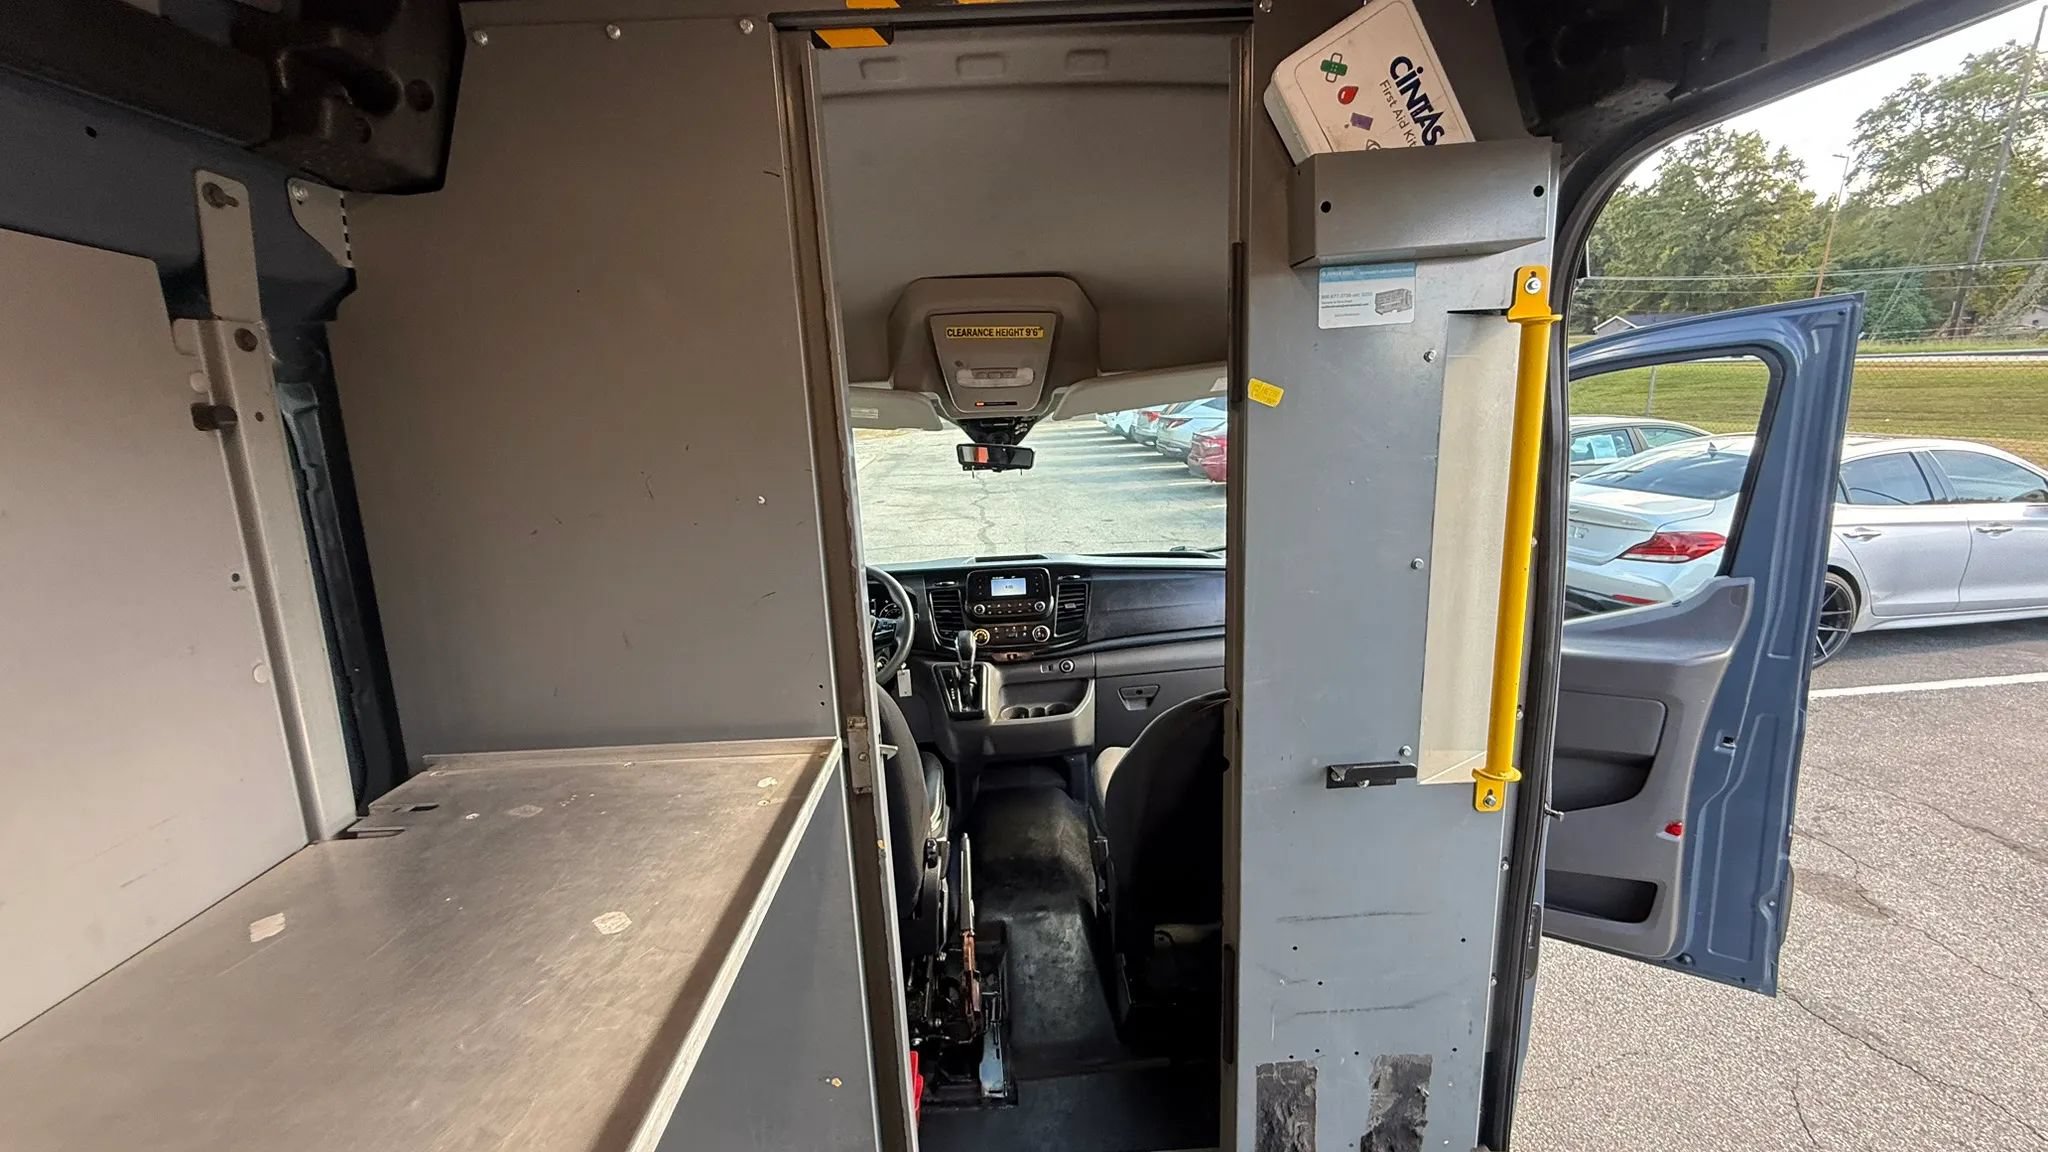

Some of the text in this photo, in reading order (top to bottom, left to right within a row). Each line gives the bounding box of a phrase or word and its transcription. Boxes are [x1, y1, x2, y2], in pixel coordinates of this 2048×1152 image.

[1379, 79, 1417, 147] First Aid Kit
[946, 328, 994, 337] CLEARANCE
[995, 328, 1024, 337] HEIGHT
